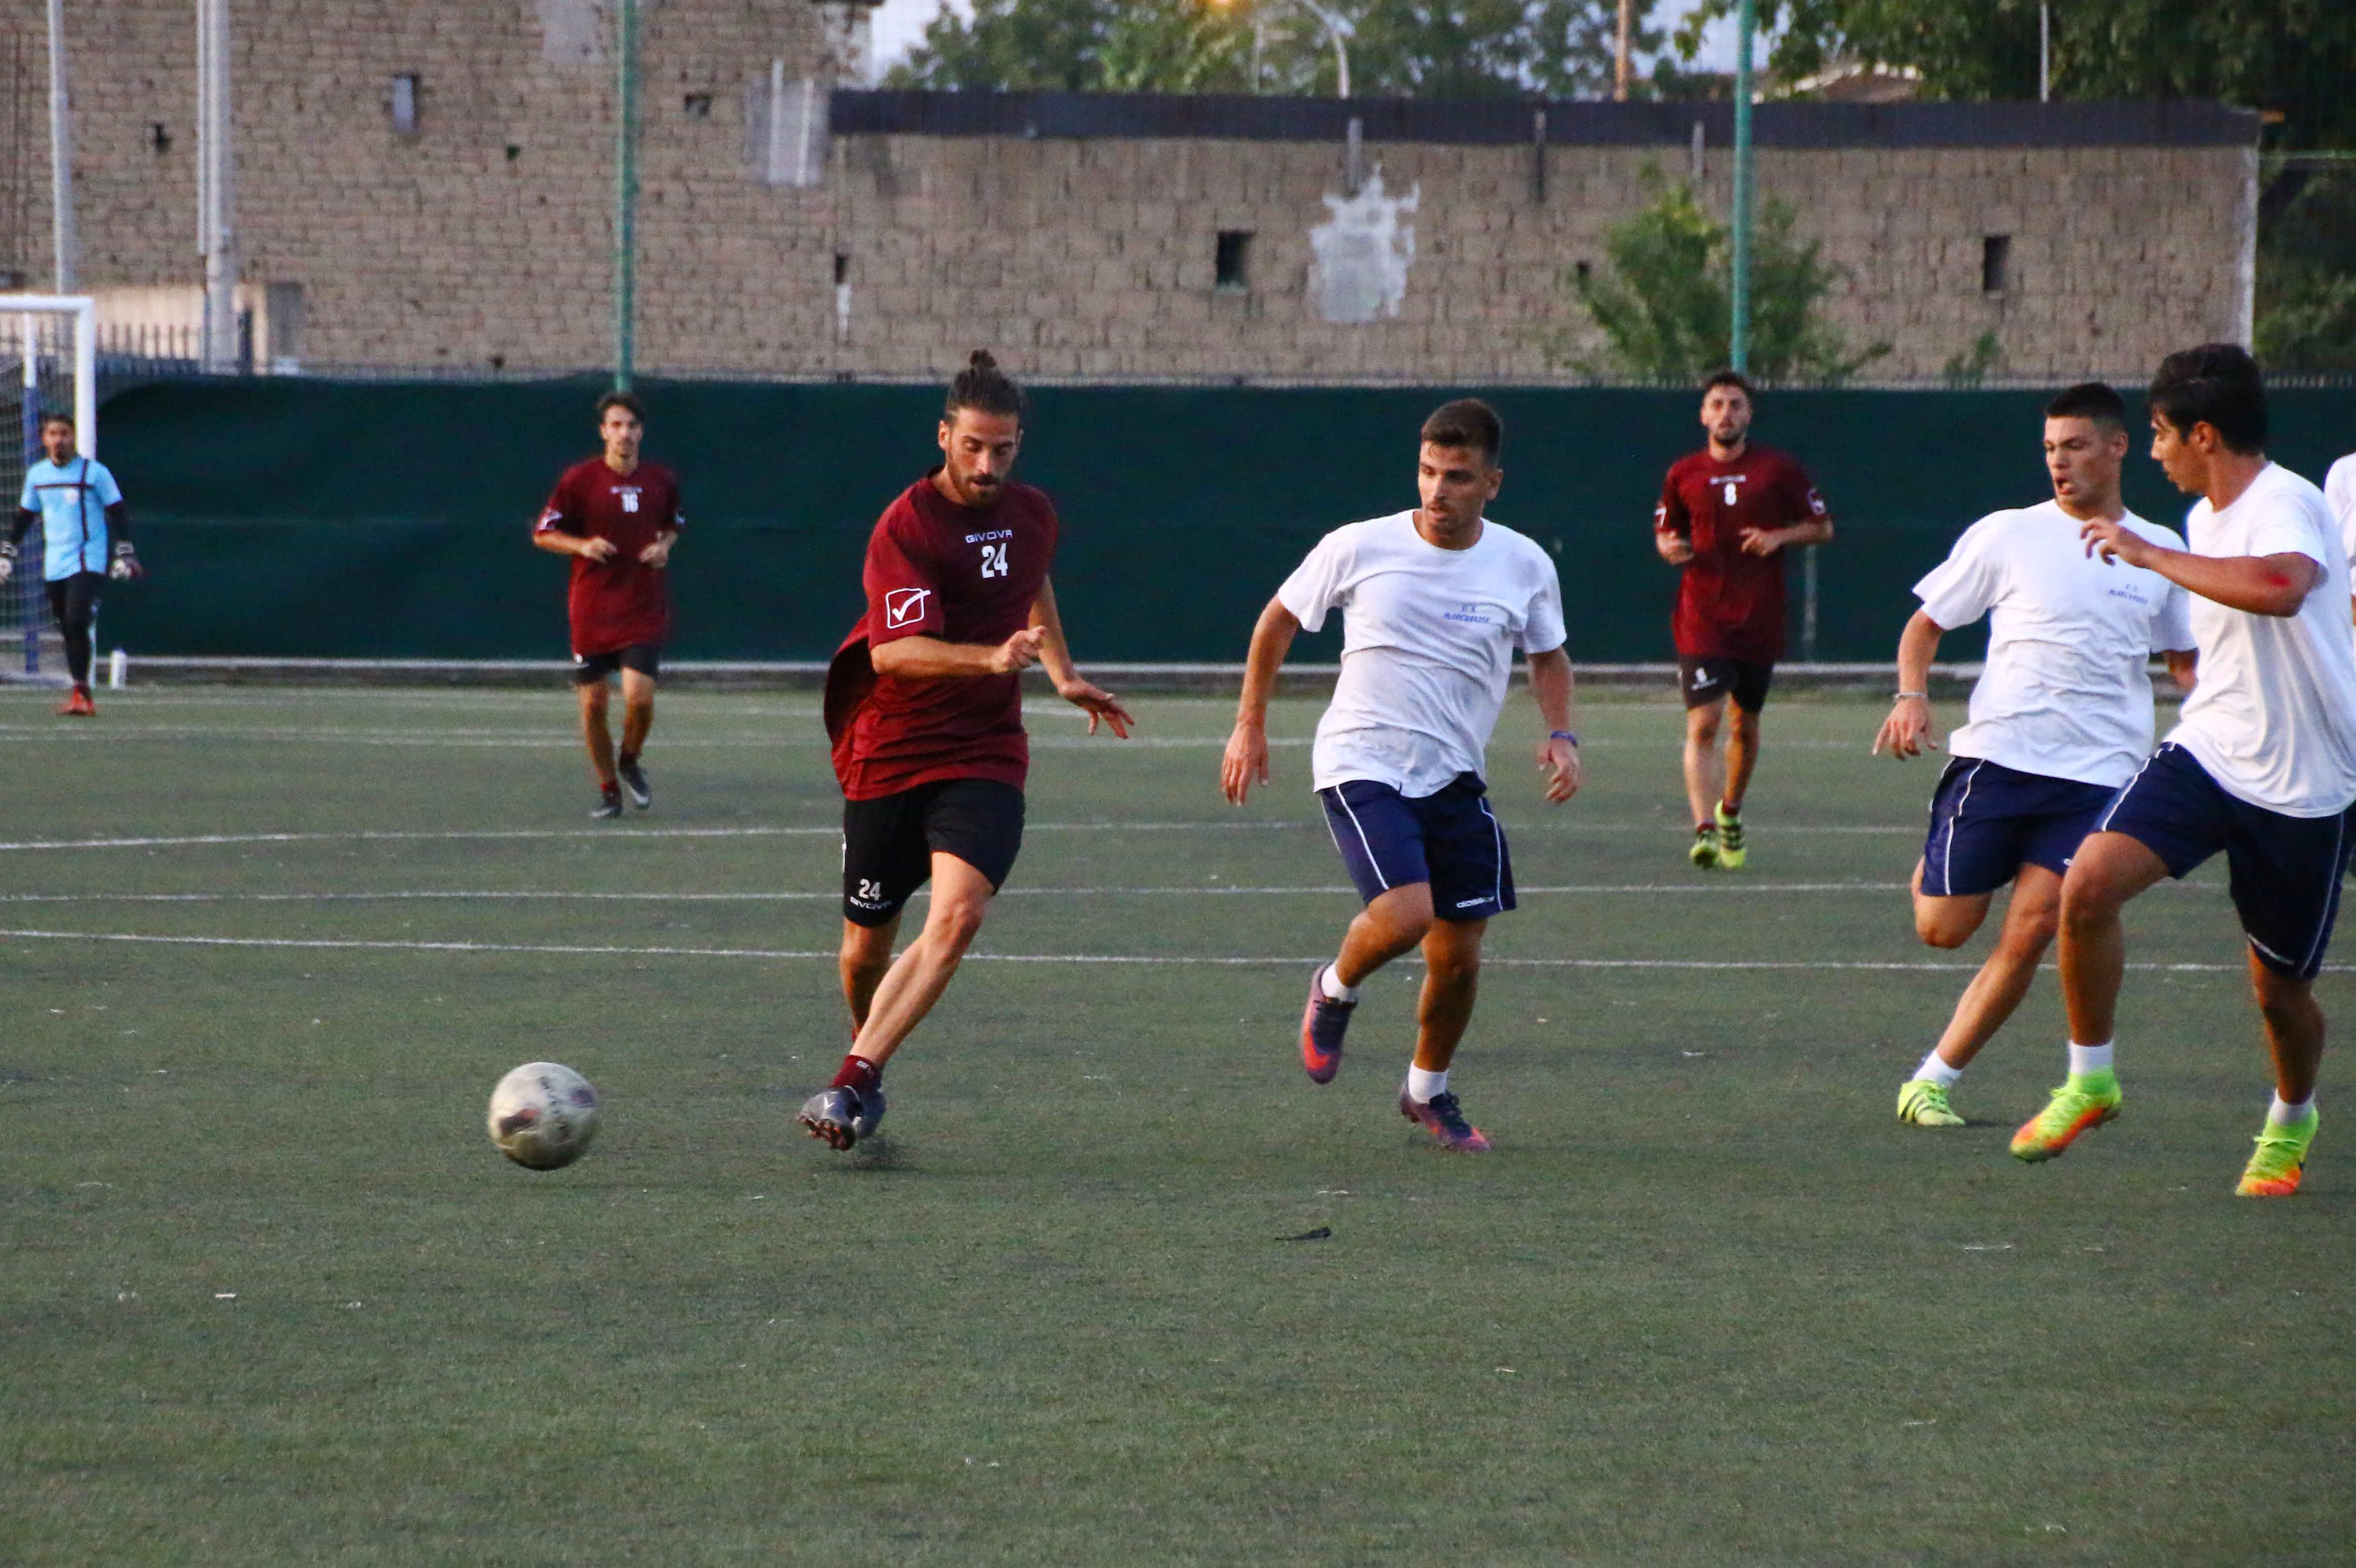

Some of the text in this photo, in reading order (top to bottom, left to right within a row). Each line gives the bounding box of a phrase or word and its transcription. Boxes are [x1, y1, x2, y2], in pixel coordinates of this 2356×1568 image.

[965, 529, 1013, 544] GIVOVA
[981, 543, 1008, 578] 24
[859, 878, 881, 901] 24
